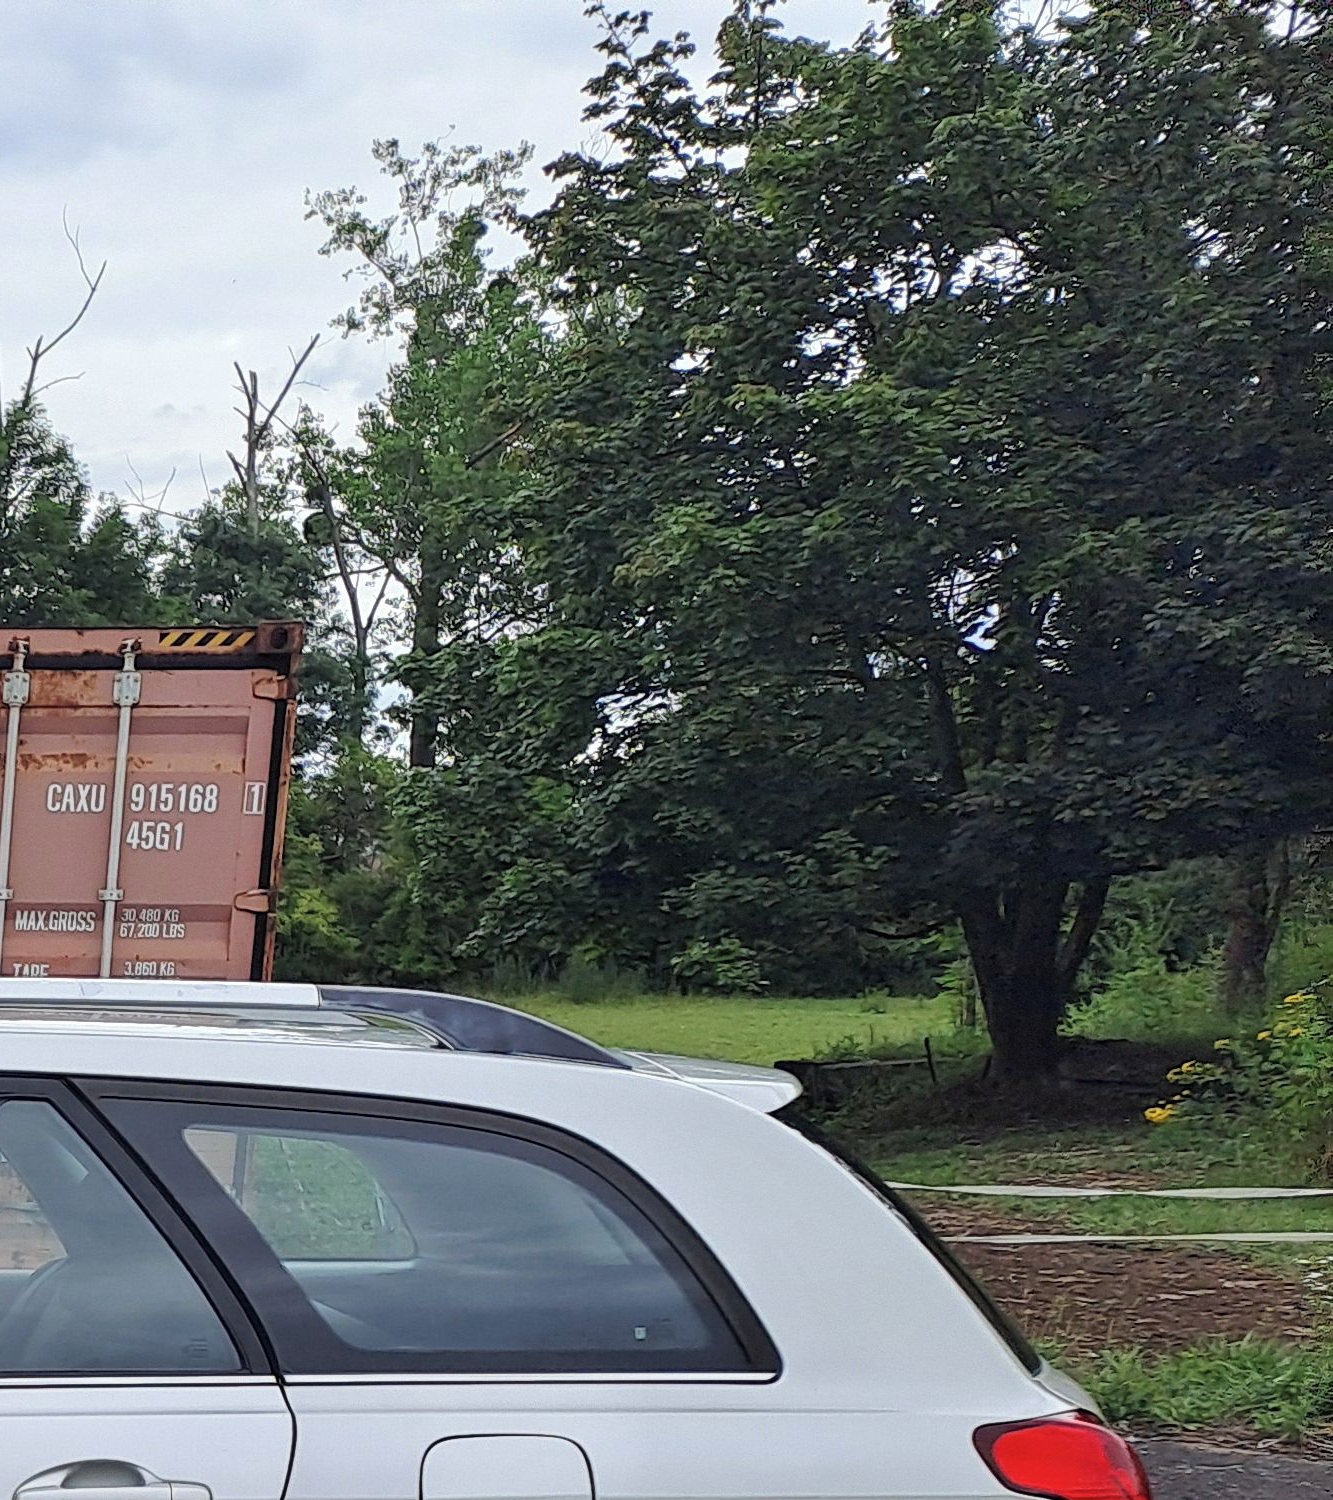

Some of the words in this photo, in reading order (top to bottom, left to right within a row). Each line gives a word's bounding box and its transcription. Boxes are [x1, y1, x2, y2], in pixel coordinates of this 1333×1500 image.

[46, 783, 106, 813] CAXU
[130, 783, 218, 813] 915168
[126, 821, 184, 850] 45G1
[164, 909, 180, 923] KG
[162, 923, 185, 938] LBS
[159, 961, 175, 976] KG
